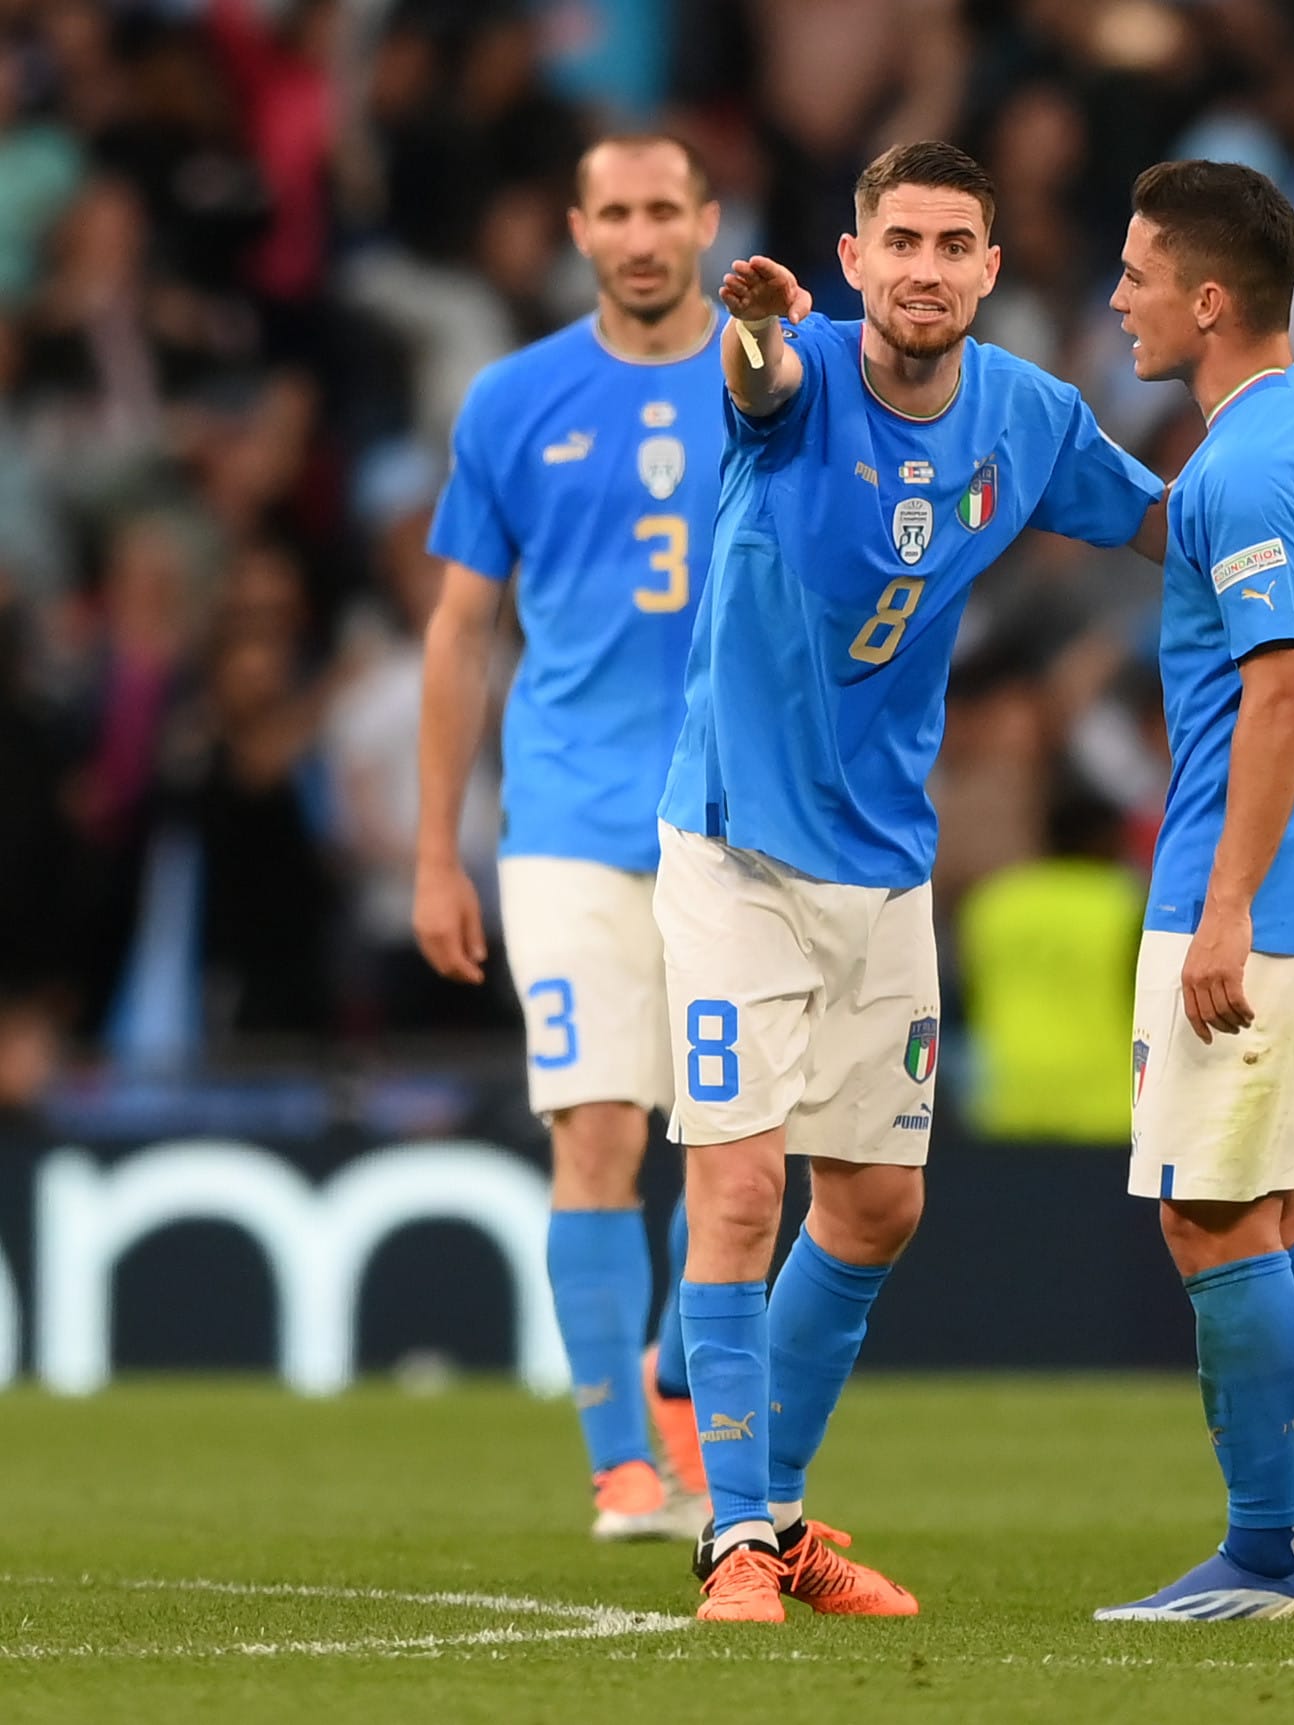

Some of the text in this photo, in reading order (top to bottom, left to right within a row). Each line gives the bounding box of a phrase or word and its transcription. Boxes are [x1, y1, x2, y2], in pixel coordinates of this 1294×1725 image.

[634, 514, 689, 613] 3
[1214, 547, 1282, 582] FOUNDATION
[848, 577, 926, 666] 8
[529, 978, 580, 1070] 3
[686, 998, 740, 1103] 8
[892, 1115, 930, 1130] PUMA
[699, 1428, 743, 1444] PUMA
